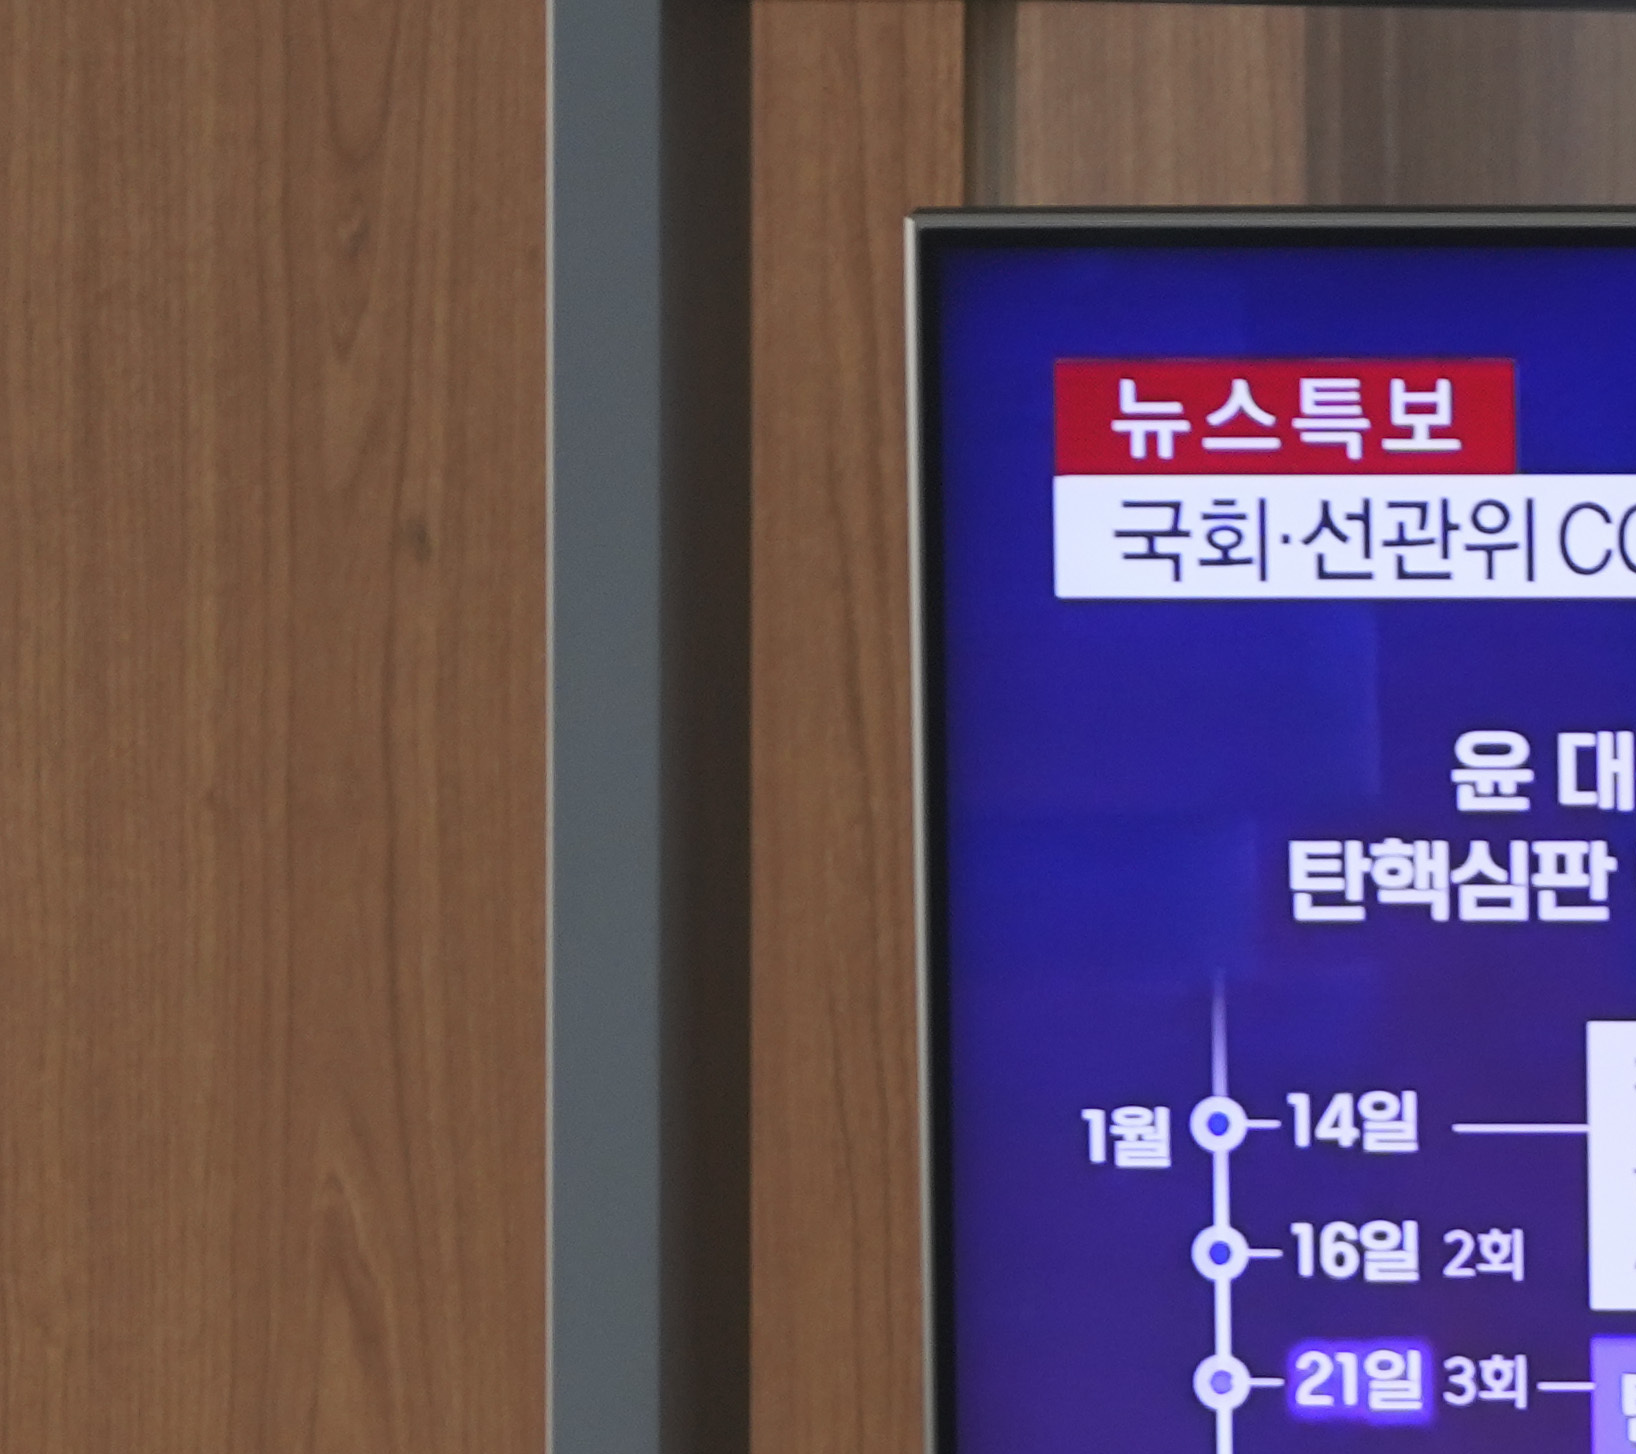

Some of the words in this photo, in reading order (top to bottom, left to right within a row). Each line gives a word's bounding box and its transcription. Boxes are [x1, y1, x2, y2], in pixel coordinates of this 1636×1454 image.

[1111, 378, 1462, 460] 뉴스특보
[1114, 498, 1534, 582] 국회·선관위
[1451, 730, 1535, 812] 윤
[1289, 837, 1618, 922] 탄핵심판
[1081, 1106, 1172, 1169] 1월
[1286, 1090, 1419, 1153] 14일
[1290, 1219, 1420, 1283] 16일
[1443, 1228, 1524, 1282] 2회
[1295, 1349, 1423, 1412] 21일
[1443, 1354, 1528, 1410] 3회
